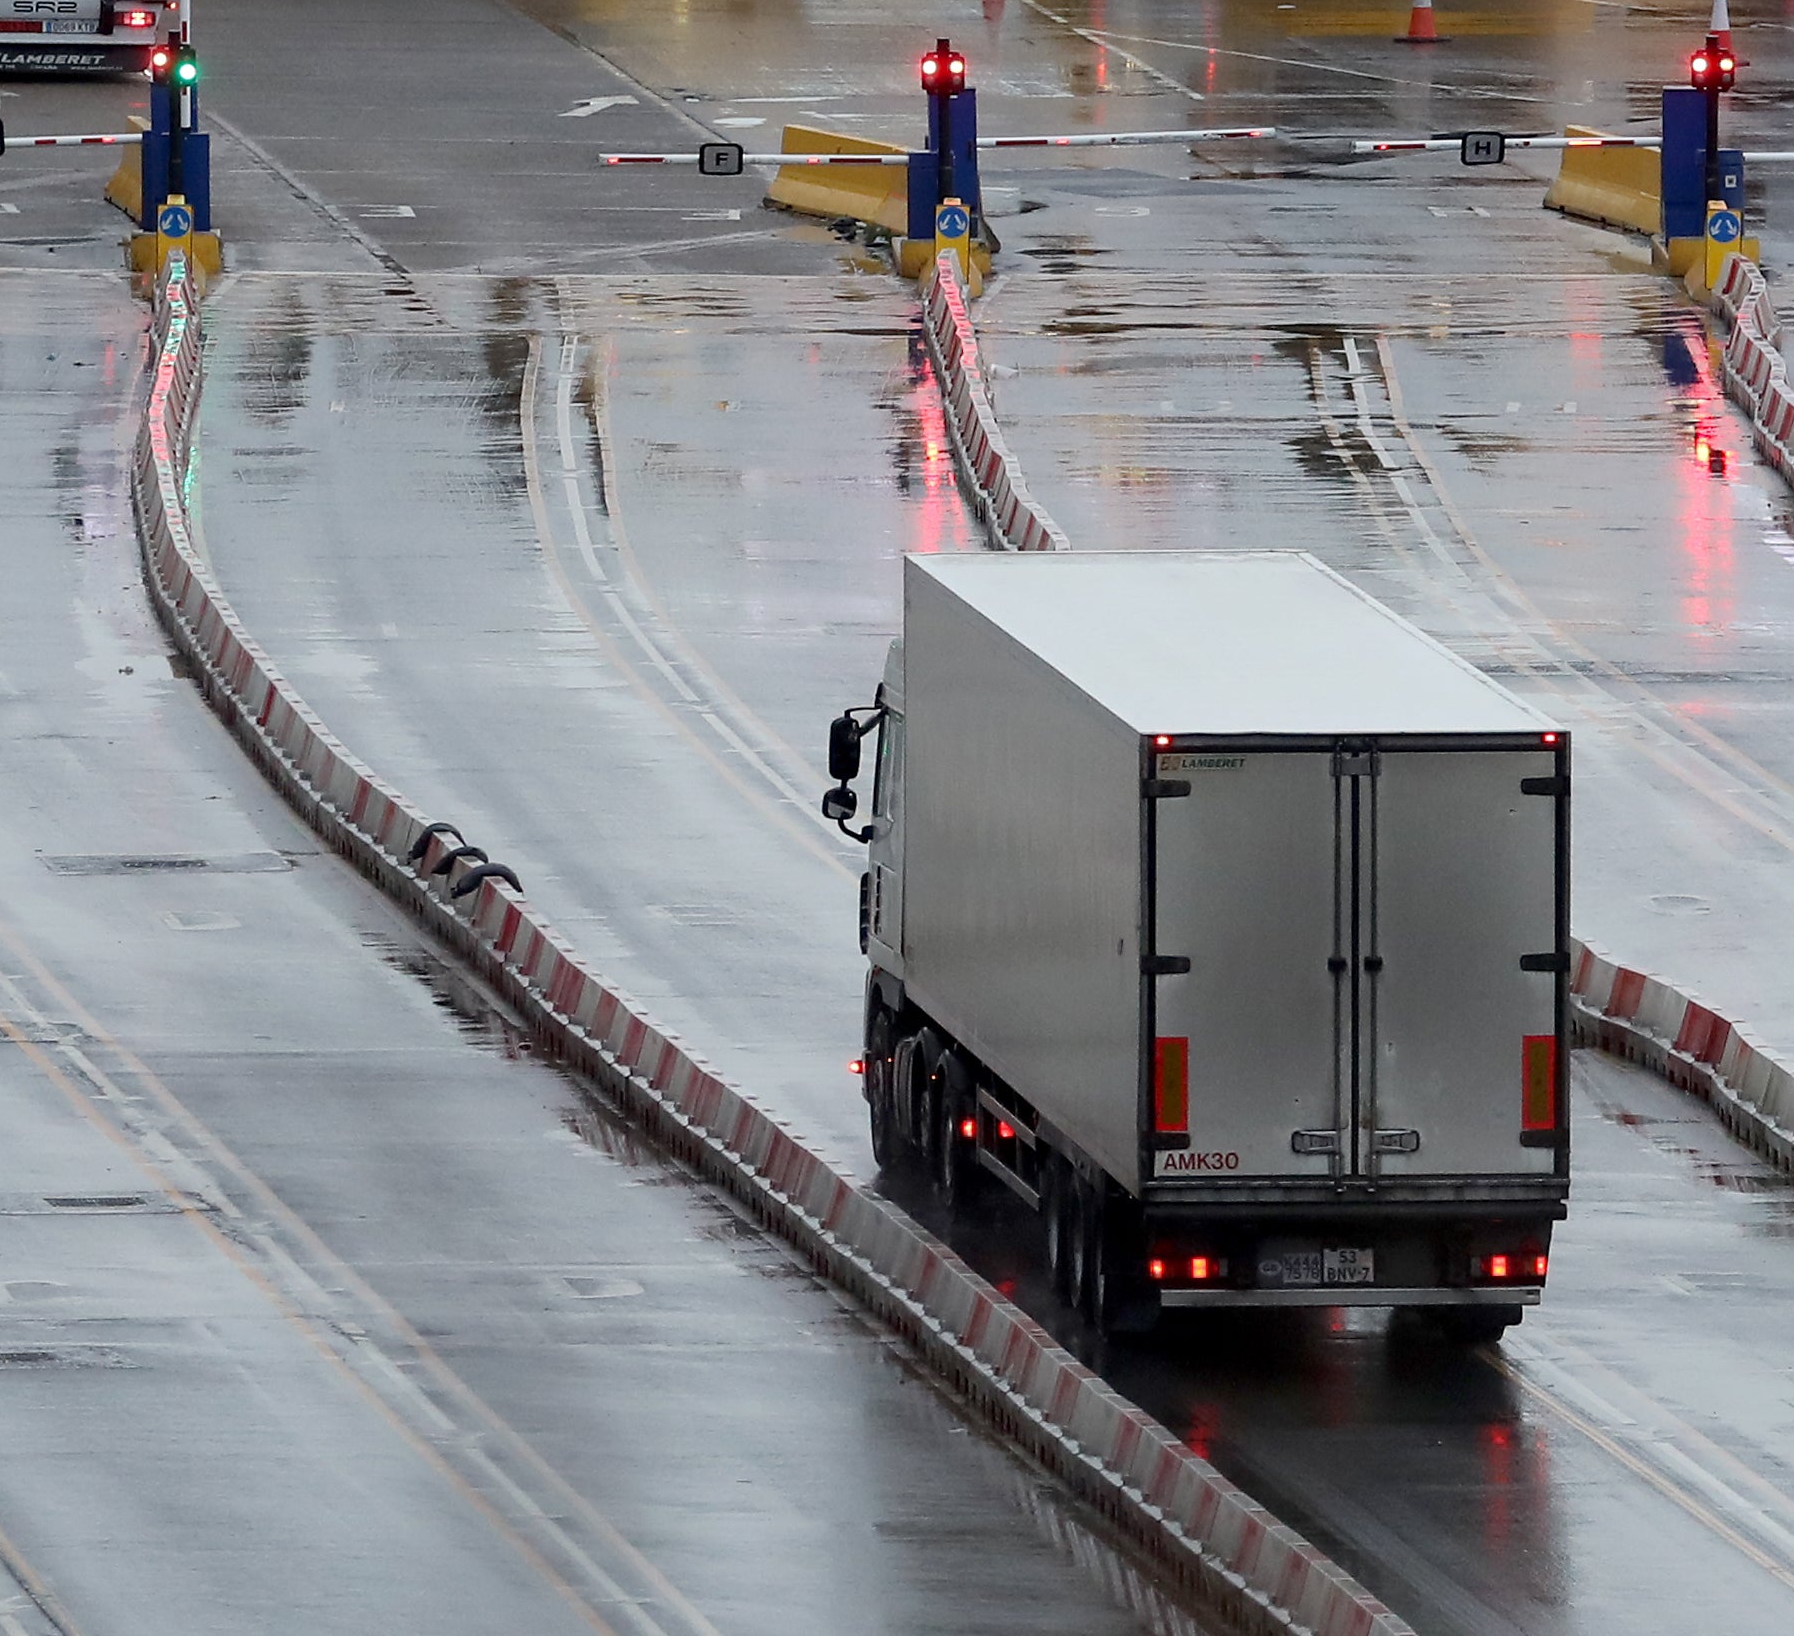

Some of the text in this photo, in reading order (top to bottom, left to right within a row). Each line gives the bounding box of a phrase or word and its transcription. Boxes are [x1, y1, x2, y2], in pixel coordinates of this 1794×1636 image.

[1, 54, 106, 65] LAMBERET
[1474, 140, 1492, 155] H
[715, 152, 729, 166] F
[1181, 758, 1246, 768] LAMBERET
[1163, 1152, 1239, 1170] AMK30
[1338, 1251, 1357, 1264] 53
